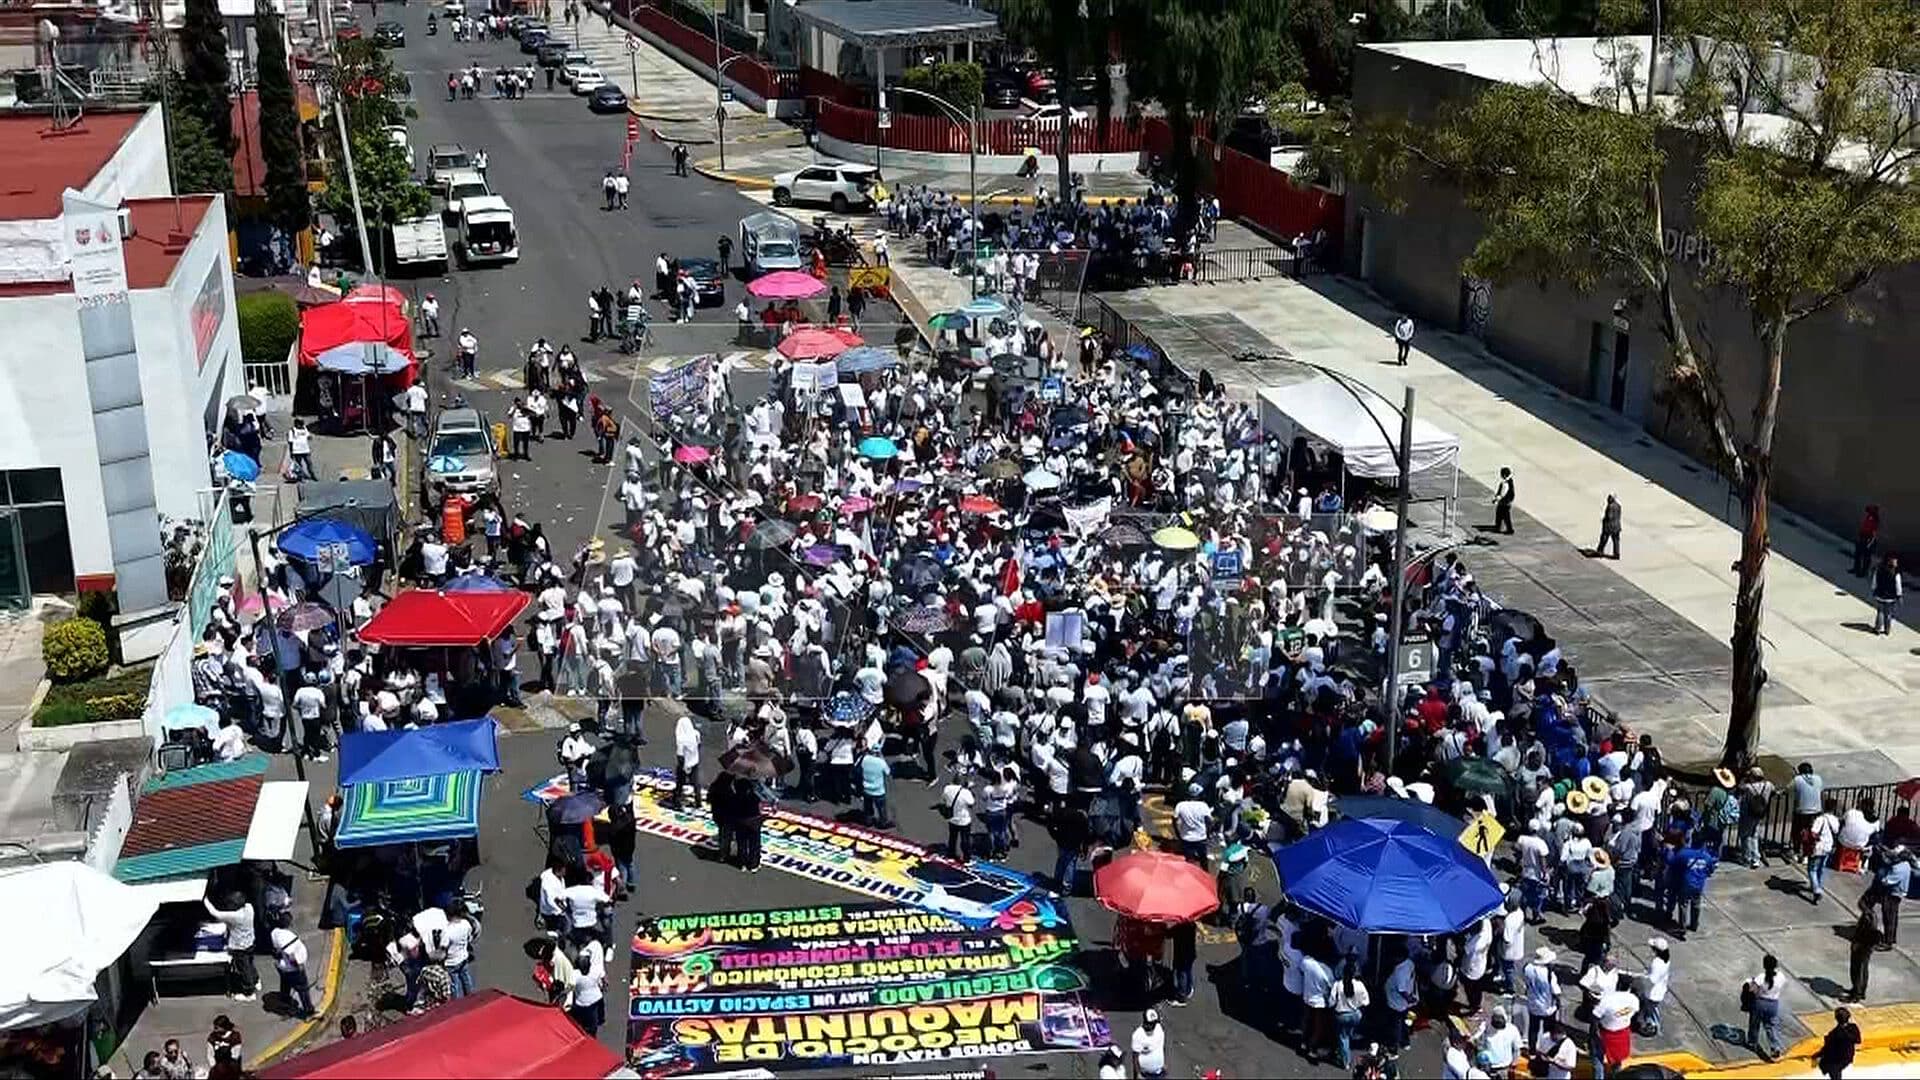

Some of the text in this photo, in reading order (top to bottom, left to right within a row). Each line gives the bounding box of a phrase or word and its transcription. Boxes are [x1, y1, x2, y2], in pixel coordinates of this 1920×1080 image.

[1665, 229, 1711, 267] DIPU
[1408, 648, 1422, 668] 6
[769, 907, 843, 925] ESTRÉS
[767, 923, 840, 939] SOCIAL
[721, 947, 868, 969] COMERCIAL
[874, 940, 960, 959] FLUJO
[859, 953, 1010, 977] DINAMISMO
[639, 998, 715, 1014] ACTIVO
[719, 995, 811, 1011] ESPACIO
[813, 994, 836, 1007] UN
[837, 991, 870, 1005] HAY
[673, 994, 1040, 1046] MAQUINITAS
[714, 1024, 1018, 1062] NEGOCIO DE
[852, 1053, 887, 1065] UN
[892, 1048, 942, 1063] HAY
